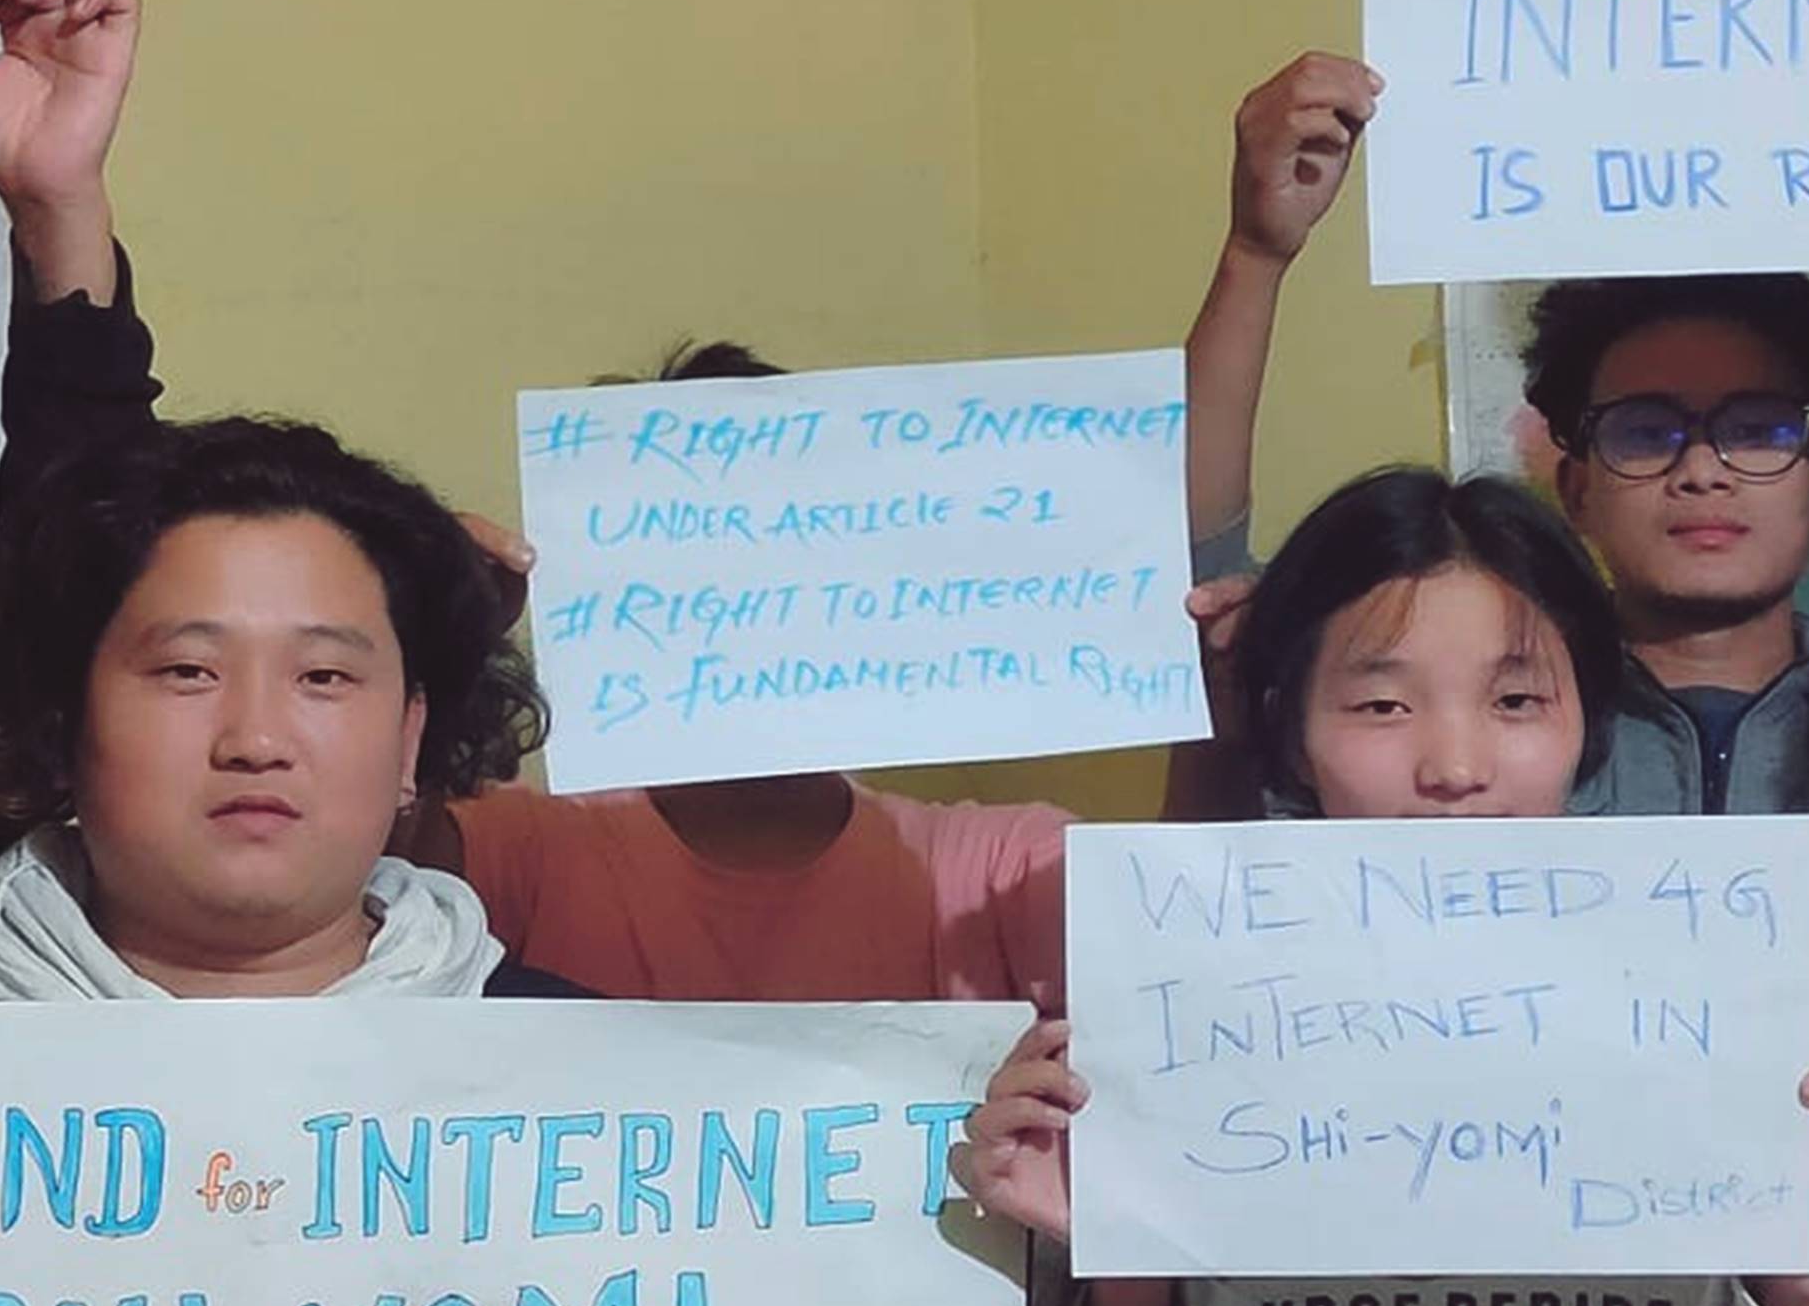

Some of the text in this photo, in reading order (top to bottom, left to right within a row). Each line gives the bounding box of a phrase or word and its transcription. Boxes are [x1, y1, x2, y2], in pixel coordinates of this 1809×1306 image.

[1470, 146, 1545, 221] IS
[1595, 149, 1729, 213] OUR
[629, 408, 827, 483] RIGHT
[861, 408, 931, 447] TO
[938, 398, 1186, 452] INTERNET
[588, 501, 755, 545] UNDER
[979, 486, 1067, 523] 21
[593, 673, 649, 733] IS
[666, 648, 1047, 721] FUNDAMENTAL
[1129, 847, 1777, 947] WE NEED 4G
[1139, 974, 1557, 1075] INTERNET
[197, 1149, 287, 1217] for
[302, 1103, 981, 1244] INTERNET
